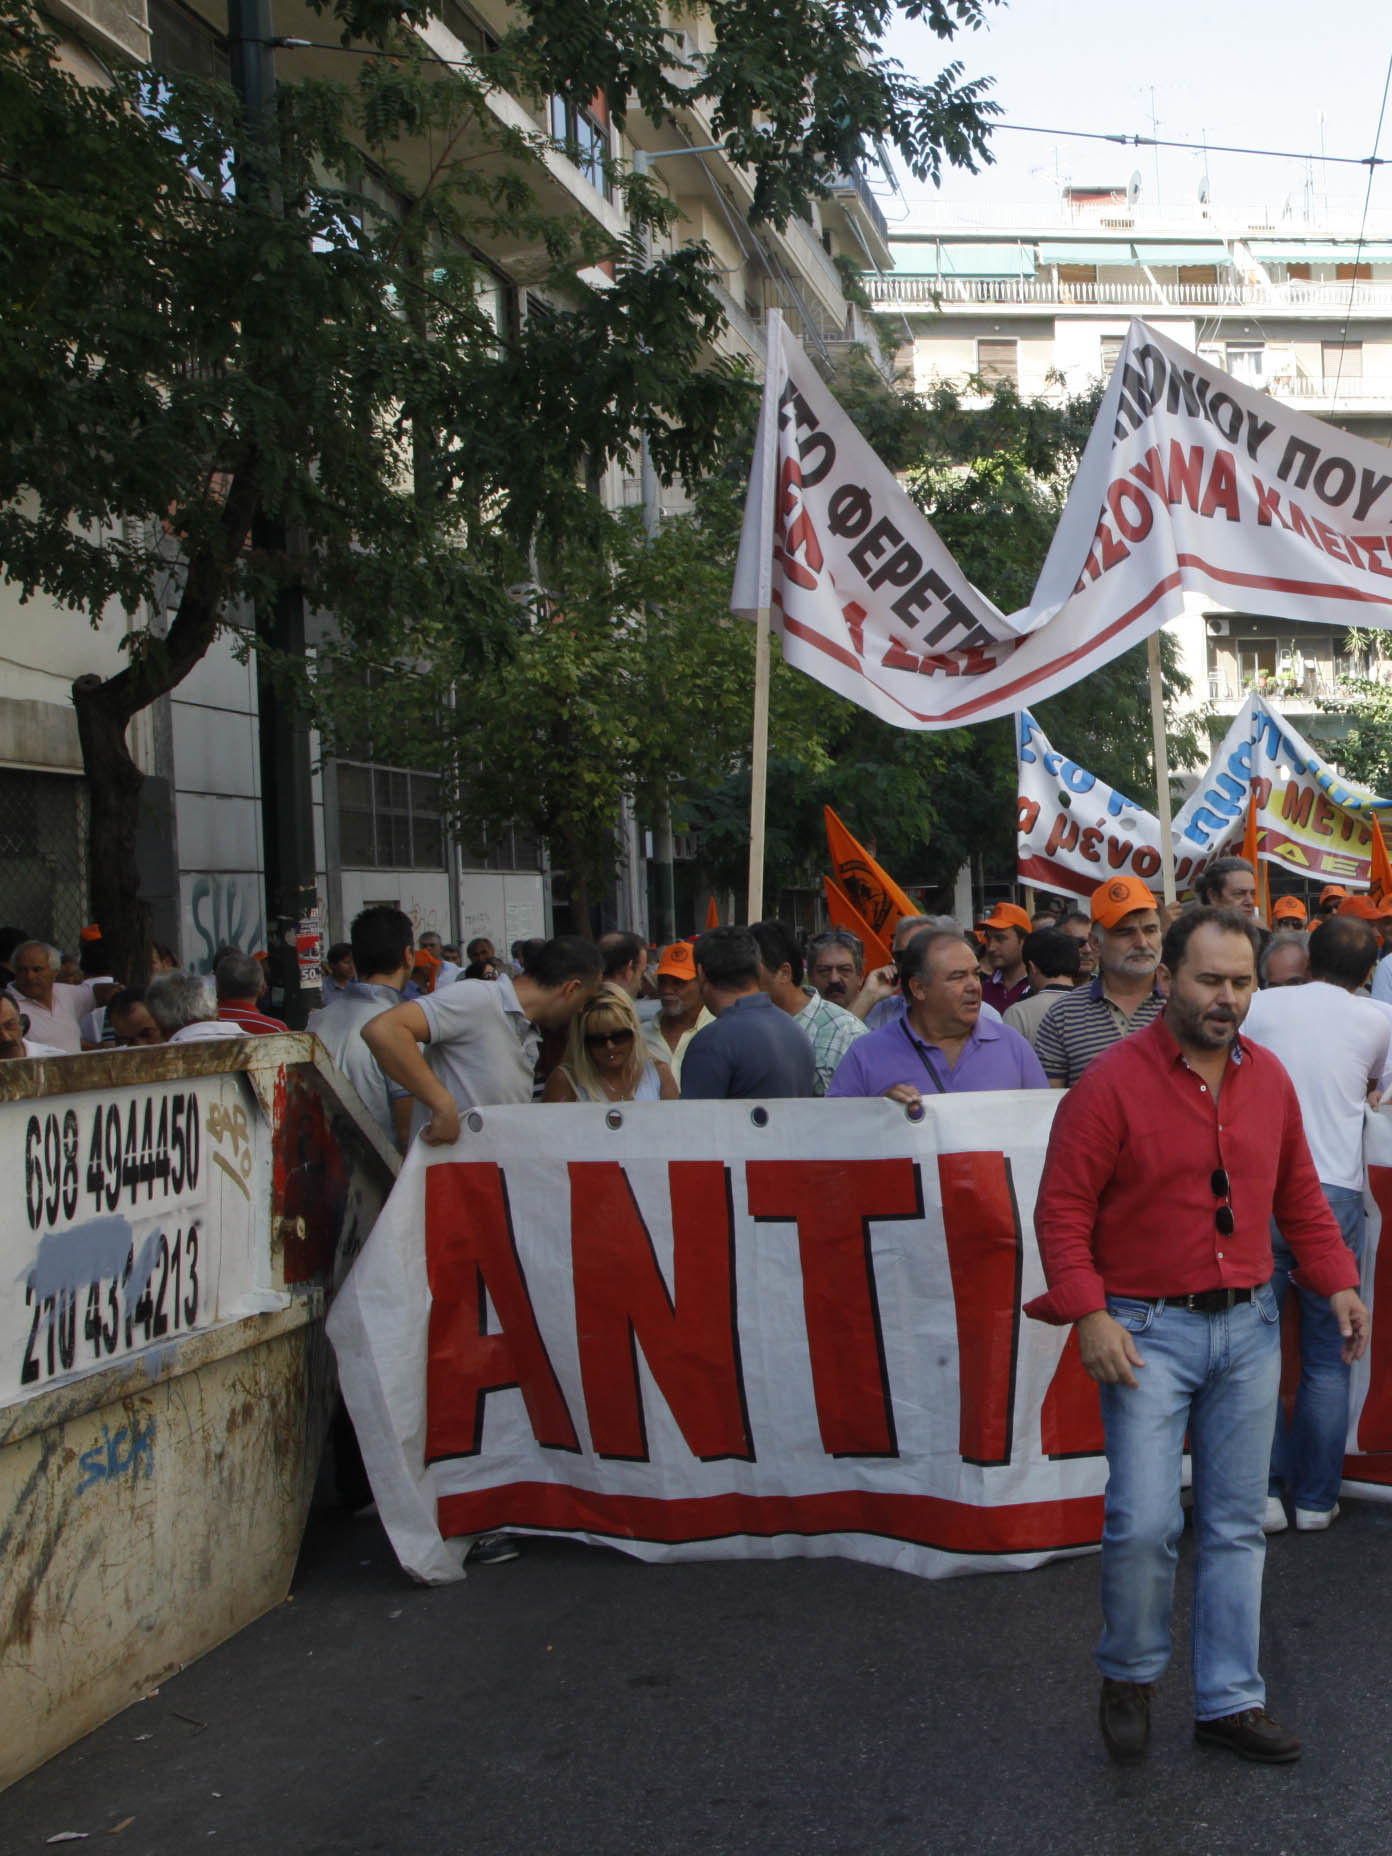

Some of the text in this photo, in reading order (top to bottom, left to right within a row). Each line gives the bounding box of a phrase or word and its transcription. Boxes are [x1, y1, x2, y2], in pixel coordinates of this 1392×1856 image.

[1276, 436, 1392, 521] ΠΟΥ
[26, 1109, 79, 1230] 698
[86, 1091, 199, 1213] 4944450
